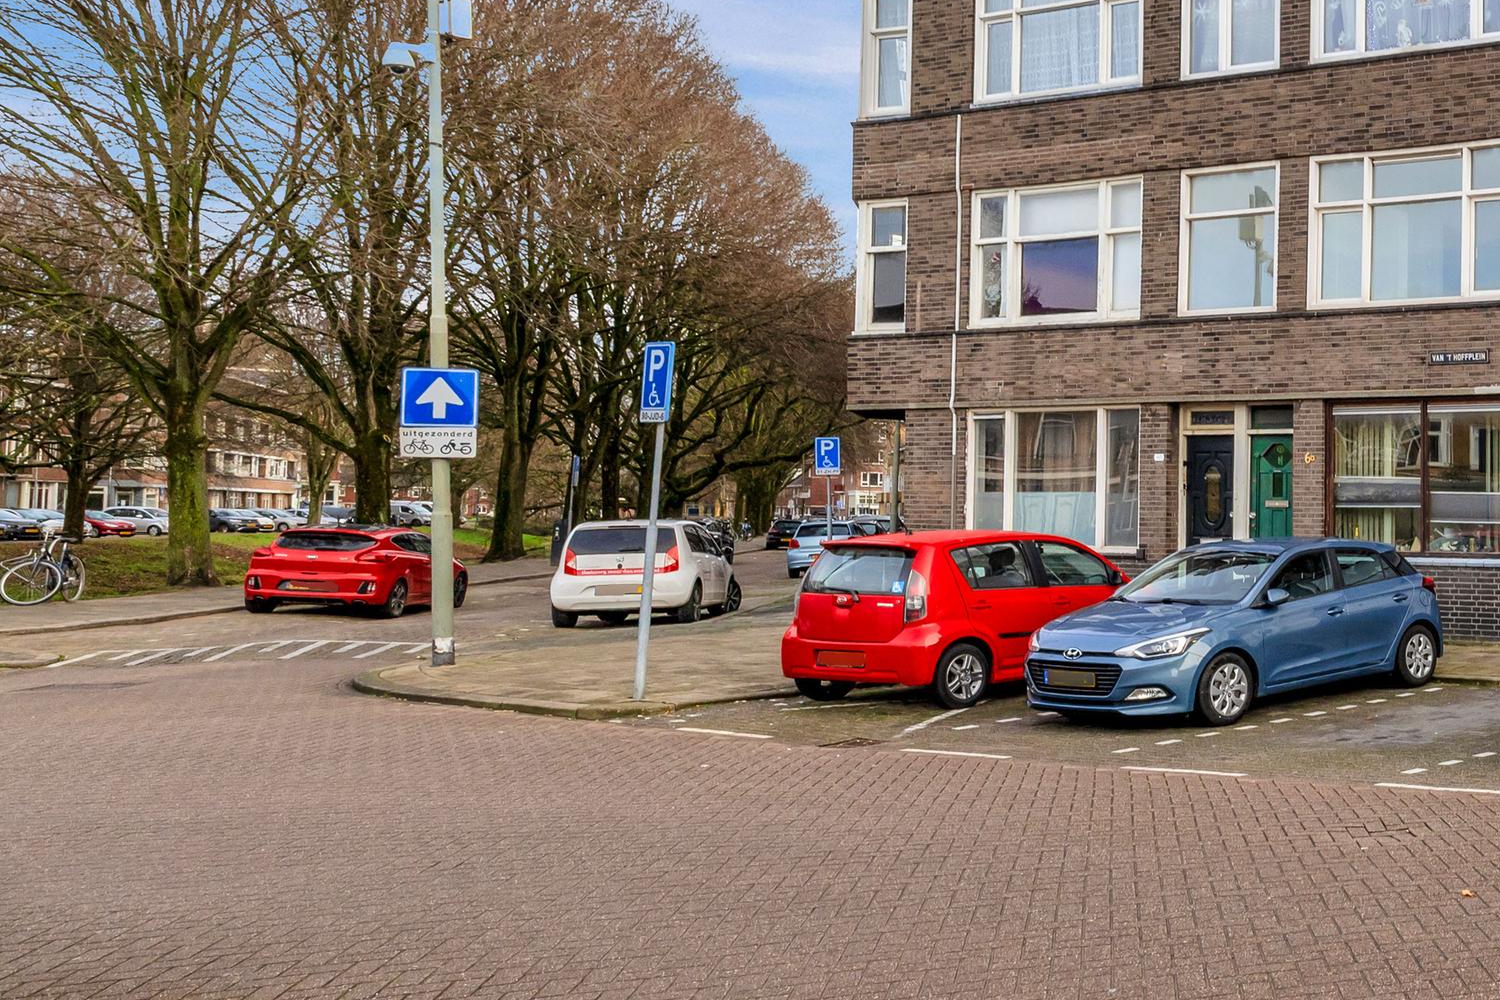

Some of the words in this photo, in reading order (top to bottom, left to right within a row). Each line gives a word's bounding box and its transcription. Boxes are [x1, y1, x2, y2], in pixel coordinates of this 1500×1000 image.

[1431, 354, 1444, 362] VAN
[1453, 352, 1486, 361] HOFFPLEIN
[649, 349, 665, 382] P
[402, 430, 473, 438] uitgezonderd
[820, 440, 834, 456] P
